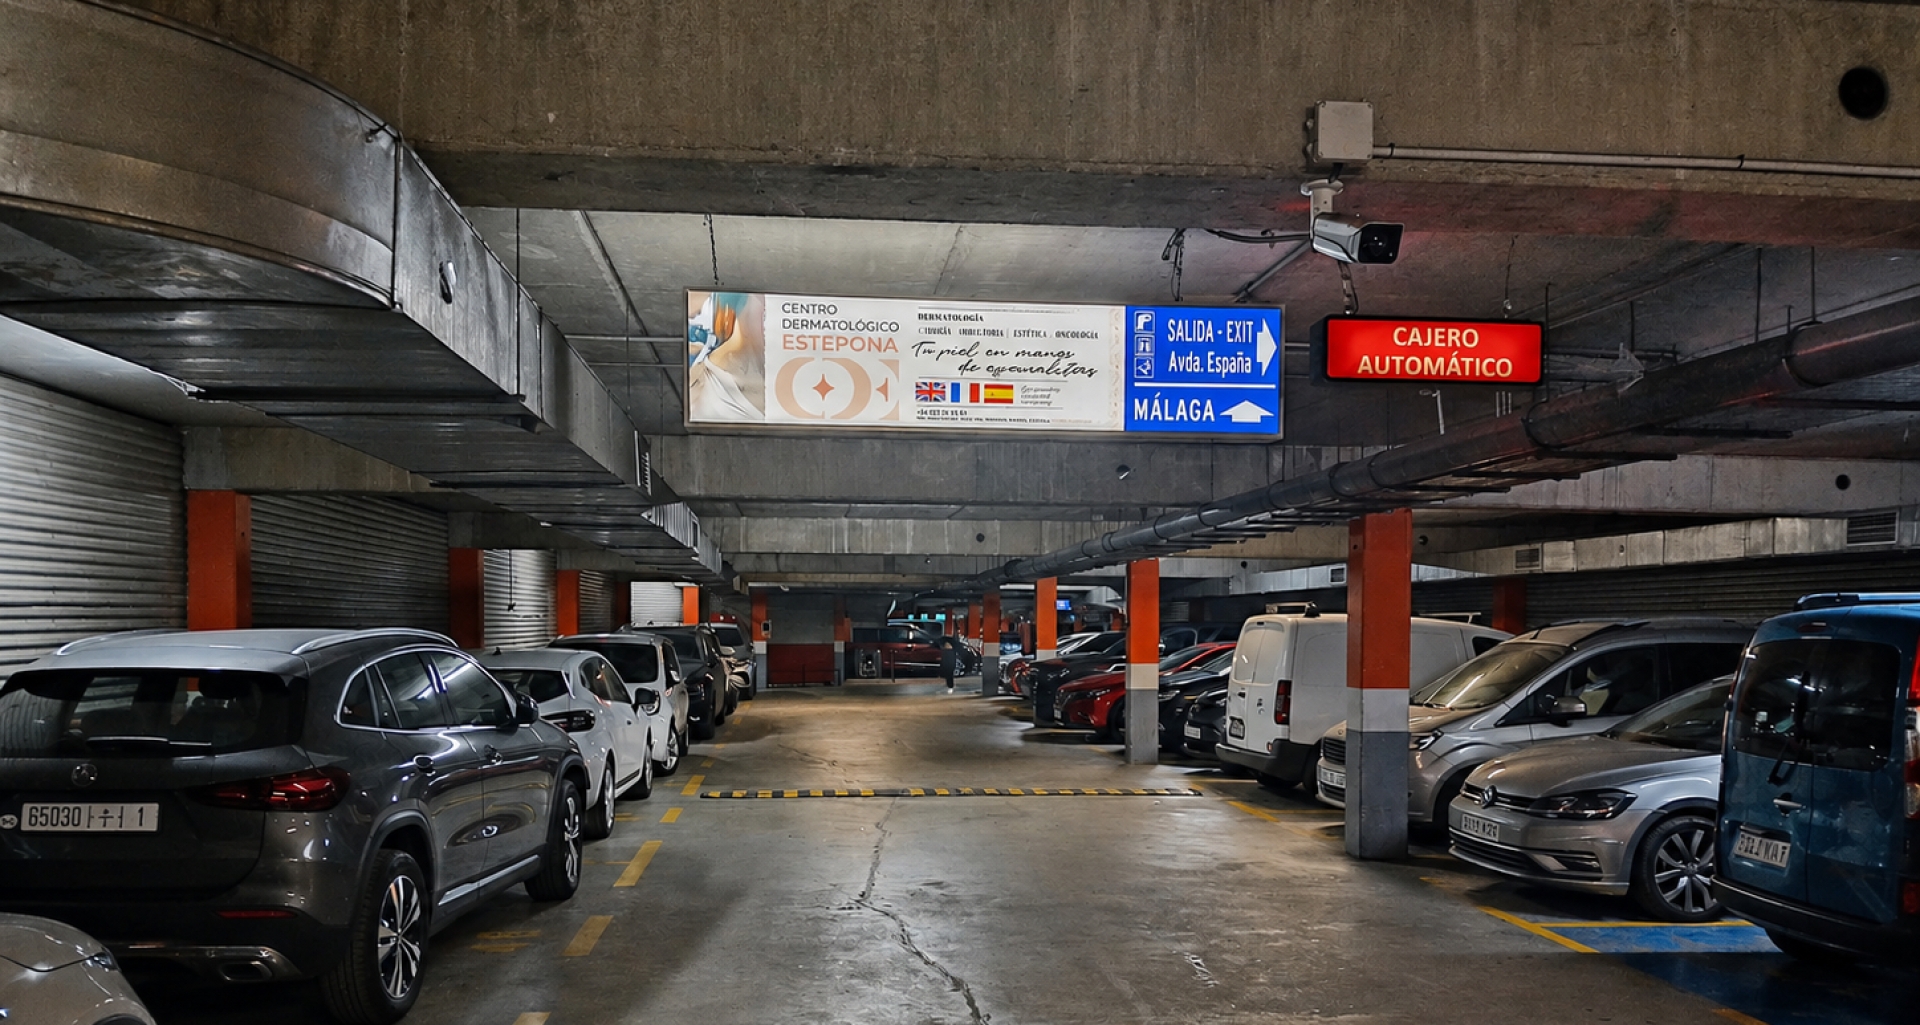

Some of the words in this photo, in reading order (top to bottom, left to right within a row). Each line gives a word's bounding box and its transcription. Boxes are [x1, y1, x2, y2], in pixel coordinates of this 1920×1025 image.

[781, 303, 838, 315] CENTRO
[781, 318, 900, 333] DERMATOLÓGICO
[1167, 318, 1214, 343] SALIDA
[1226, 320, 1254, 343] EXIT
[782, 334, 899, 353] ESTEPONA
[1393, 326, 1479, 348] CAJERO
[1168, 351, 1204, 373] Avda.
[1207, 351, 1251, 378] España
[1357, 351, 1513, 378] AUTOMÁTICO
[1134, 391, 1215, 423] MÁLAGA
[28, 806, 82, 827] 65030
[137, 806, 144, 827] 1
